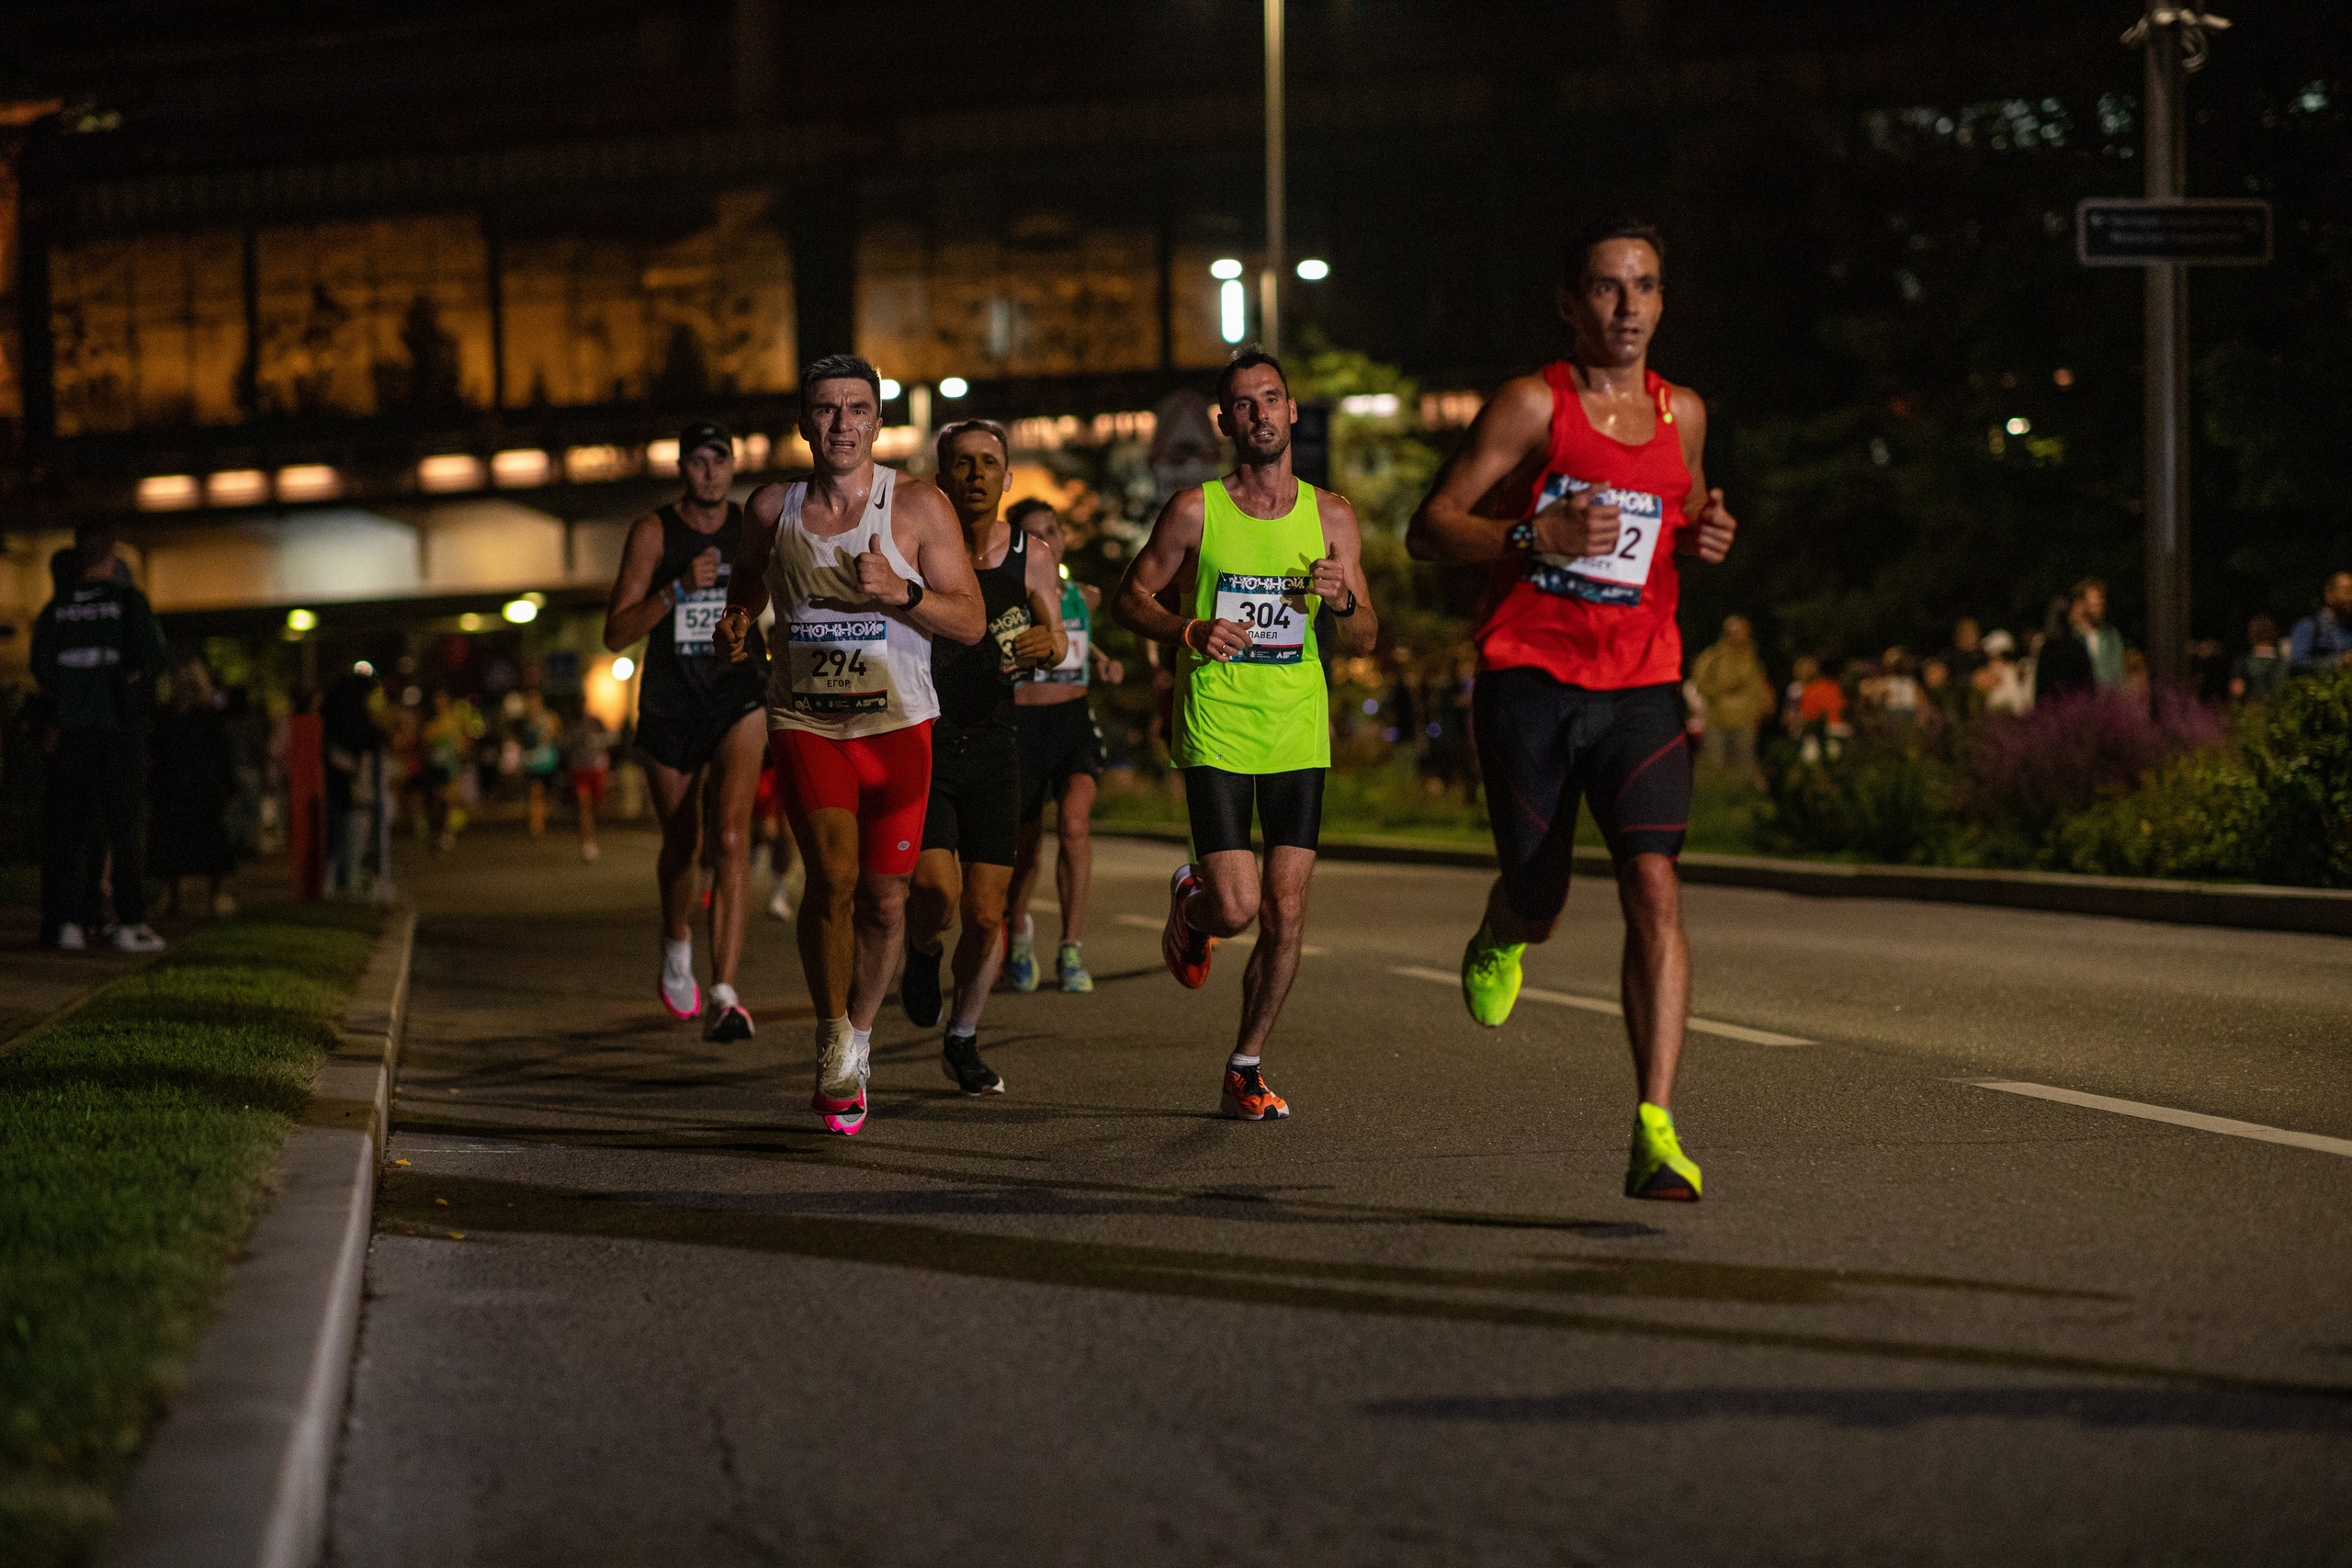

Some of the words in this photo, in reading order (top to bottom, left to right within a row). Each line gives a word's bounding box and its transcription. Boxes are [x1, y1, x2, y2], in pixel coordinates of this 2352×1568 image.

[1238, 602, 1290, 629] 304
[1248, 630, 1278, 639] ПАВЕЛ
[811, 649, 866, 677] 294
[827, 679, 851, 688] ЕГОР
